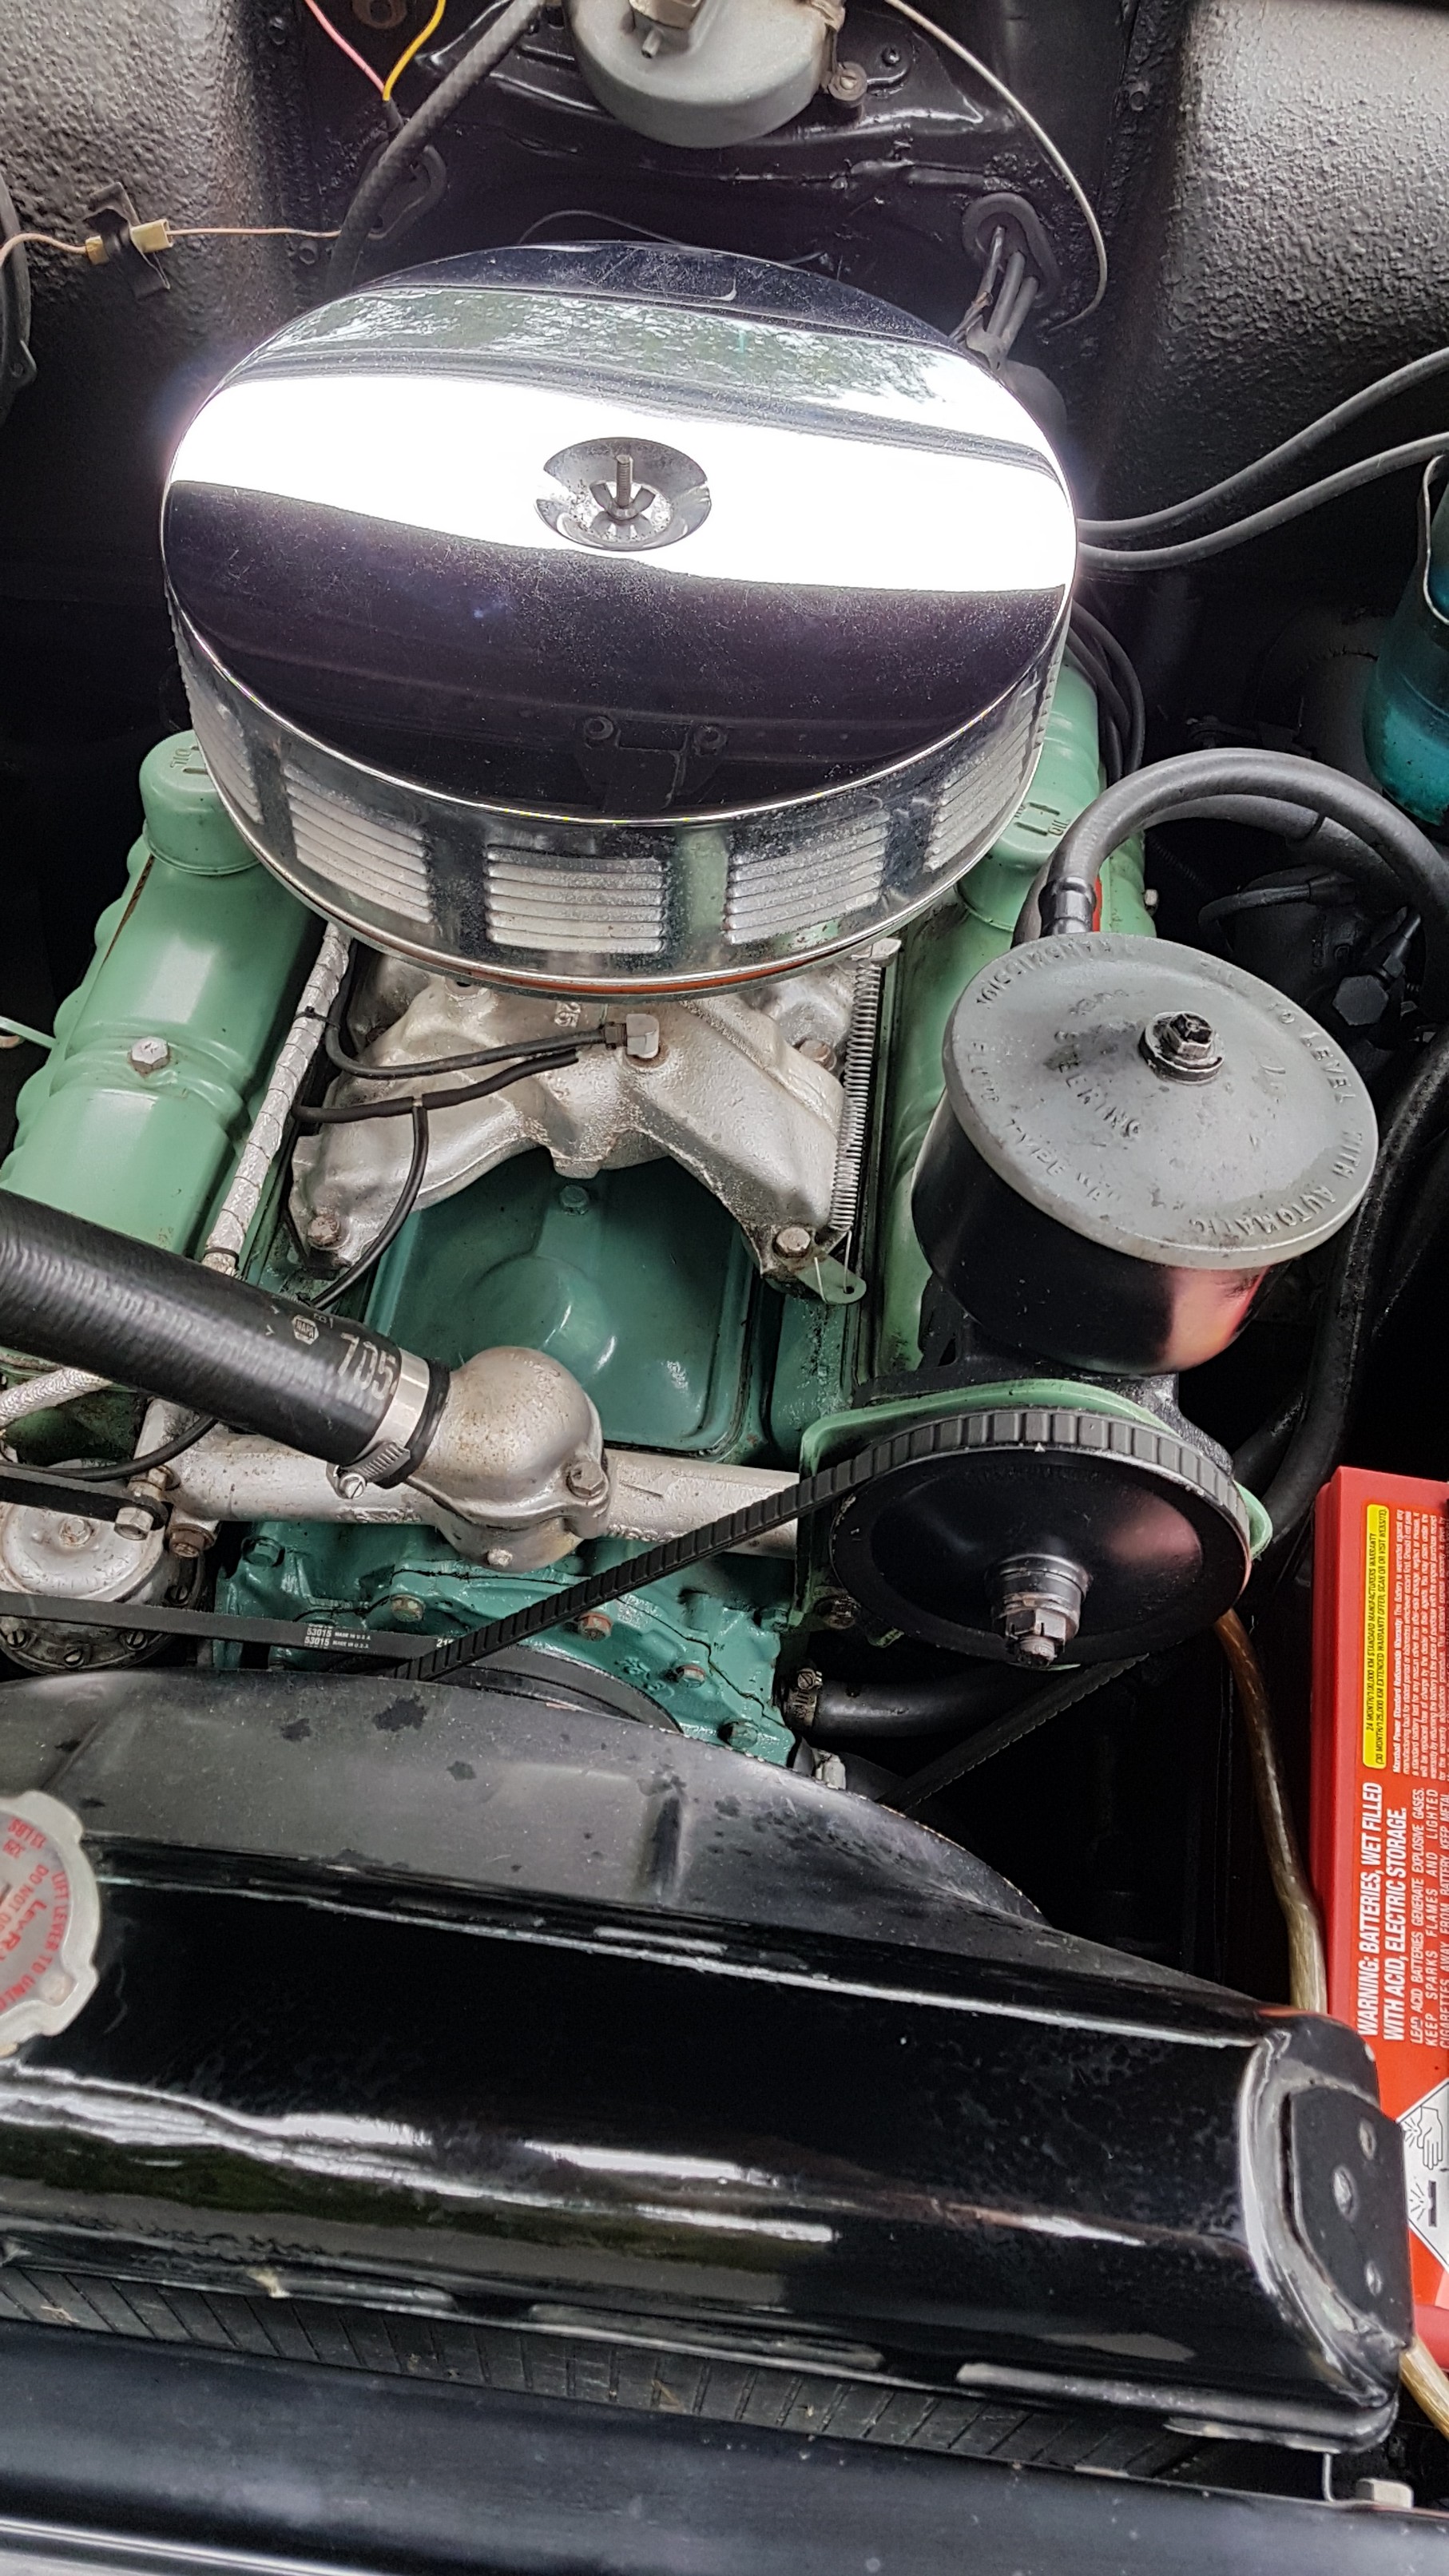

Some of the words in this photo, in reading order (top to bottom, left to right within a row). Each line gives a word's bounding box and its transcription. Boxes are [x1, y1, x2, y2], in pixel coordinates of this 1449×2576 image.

[1300, 1030, 1356, 1105] LEVEL
[1003, 1117, 1067, 1178] TYPE
[1331, 1129, 1364, 1180] WITH
[1188, 1184, 1336, 1237] AUTOMATIC
[304, 1636, 330, 1646] 53015
[307, 1627, 331, 1637] 53015
[1362, 1782, 1383, 1832] FILLED
[1412, 1788, 1424, 1820] GASES.
[1427, 1789, 1438, 1840] LIGHTED
[7, 1817, 34, 1840] LBS
[1361, 1834, 1380, 1866] WET
[1387, 1808, 1407, 1879] STORAGE.
[1411, 1825, 1423, 1874] EXPLOSIVE
[29, 1864, 49, 1885] DO
[51, 1870, 70, 1899] LIFT
[1427, 1852, 1438, 1877] AND
[8, 1884, 34, 1910] NOT
[1360, 1869, 1383, 1954] BATTERIES,
[1386, 1880, 1405, 1953] ELECTRIC
[1411, 1879, 1423, 1927] GENERATE
[1427, 1888, 1438, 1937] FLAMES
[45, 1903, 69, 1951] LEVER
[31, 1955, 53, 1974] TO
[1385, 1956, 1407, 1997] ACID,
[1411, 1931, 1423, 1983] BATTERIES
[1427, 1951, 1437, 2000] SPARKS
[1440, 1942, 1449, 1971] AWAY
[1358, 1957, 1379, 2036] WARNING:
[1384, 1998, 1404, 2042] WITH
[1411, 1988, 1422, 2012] ACID
[1440, 1979, 1449, 2049] CIGARETTES
[1411, 2017, 1422, 2043] LEAD
[1426, 2014, 1437, 2046] KEEP
